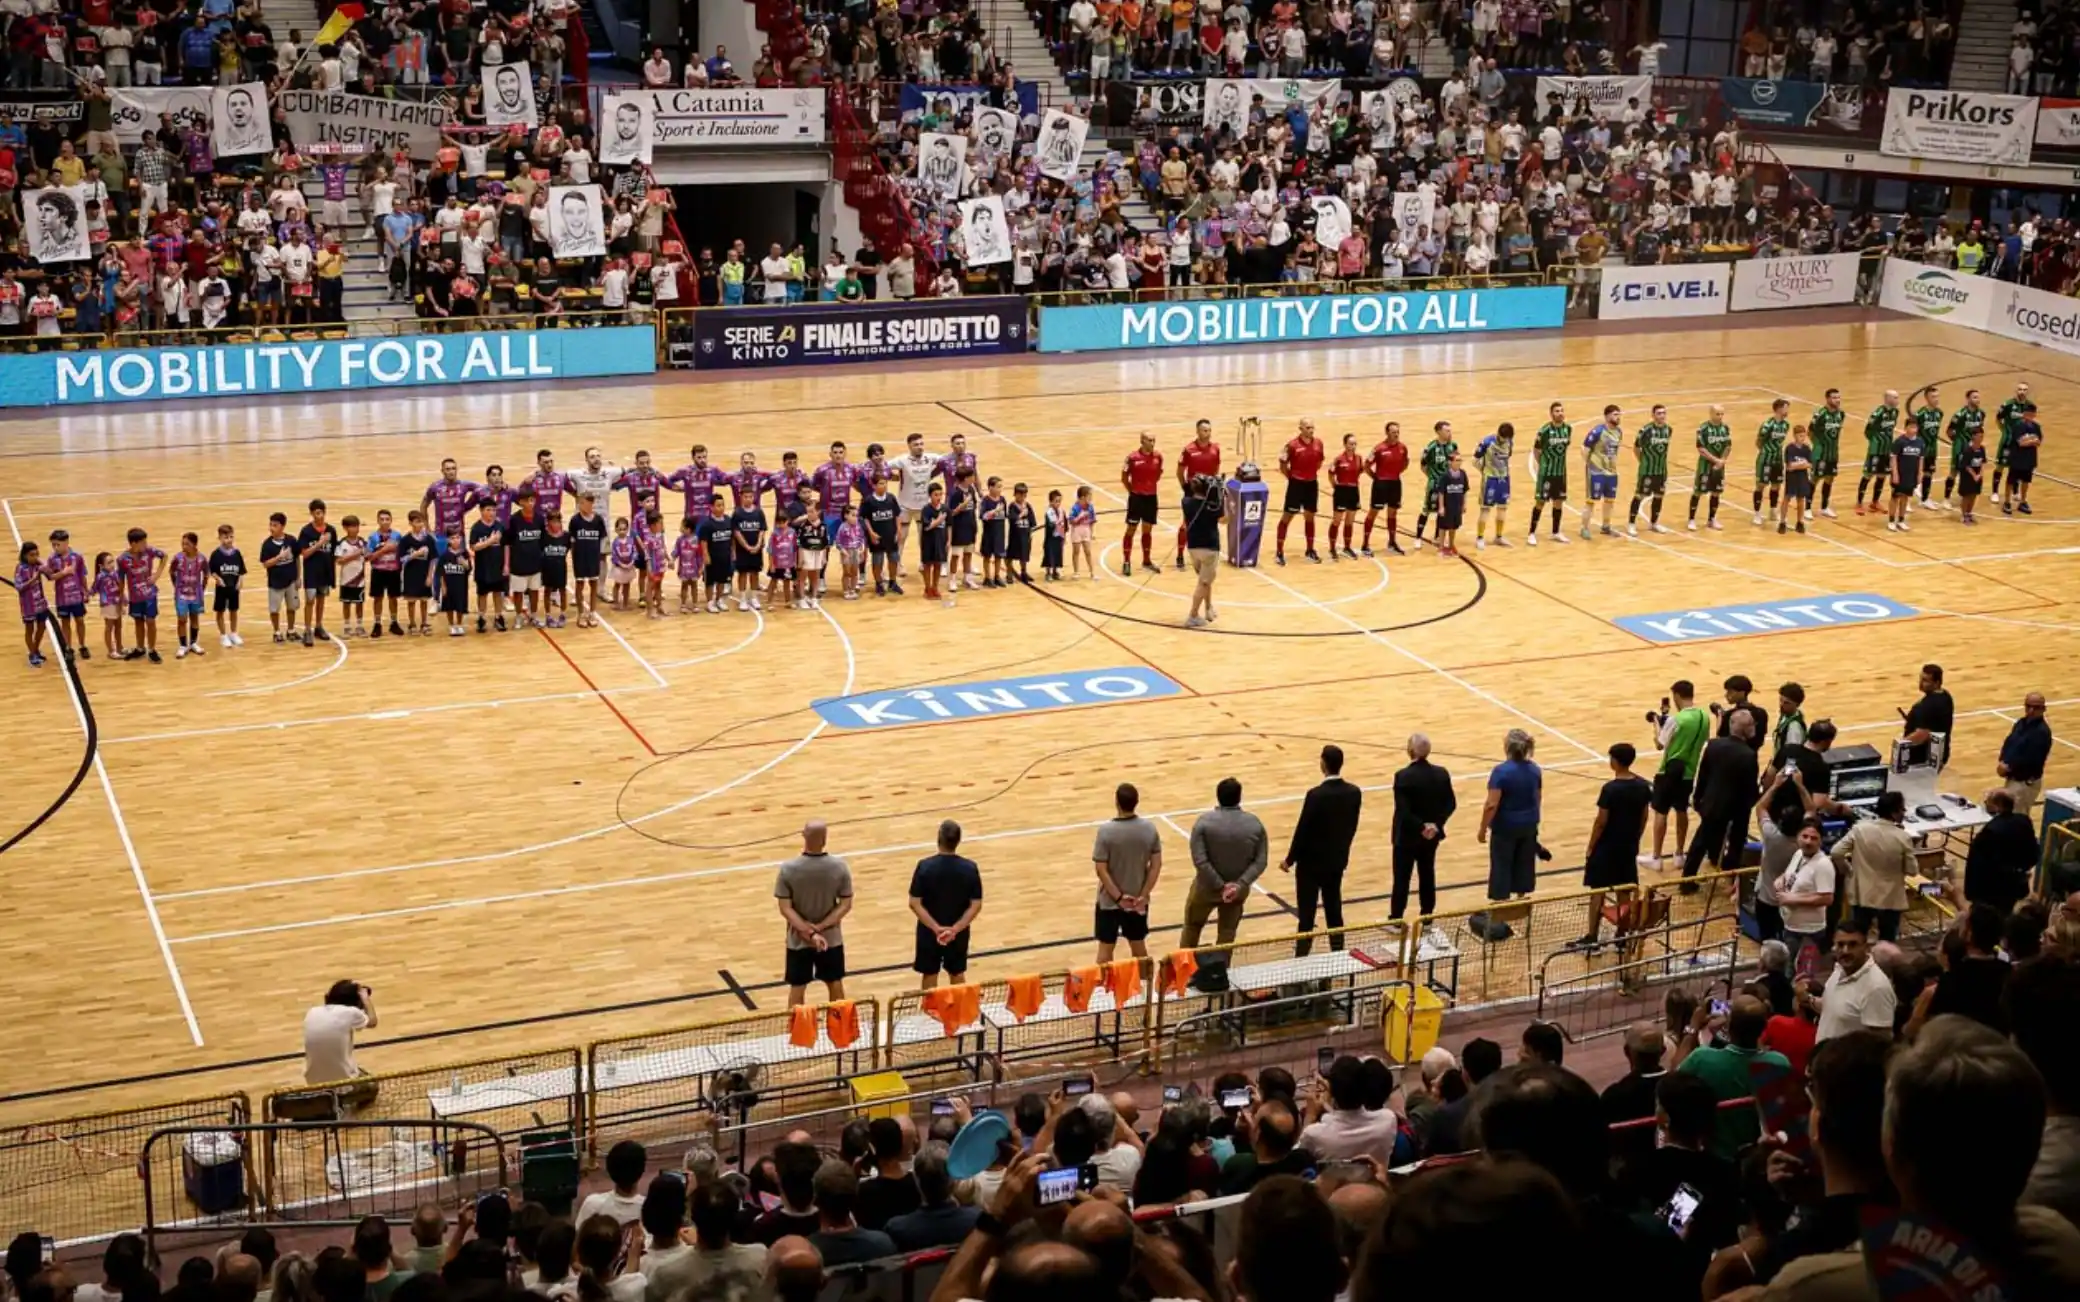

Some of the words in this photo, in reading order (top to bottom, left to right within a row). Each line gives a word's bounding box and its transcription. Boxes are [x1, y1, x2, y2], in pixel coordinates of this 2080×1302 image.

[284, 93, 444, 127] COMBATTIAMO
[672, 91, 765, 113] Catania
[1907, 93, 2015, 126] PriKors
[653, 121, 695, 139] Sport
[708, 119, 780, 137] Inclusione
[1765, 259, 1832, 279] LUXURY
[1904, 279, 1969, 304] ecocenter
[1121, 299, 1321, 345] MOBILITY
[1330, 296, 1408, 335] FOR
[1418, 292, 1488, 330] ALL
[724, 327, 774, 345] SERIE
[804, 319, 886, 349] FINALE
[887, 314, 1000, 346] SCUDETTO
[833, 345, 895, 357] STAGIONE
[56, 344, 325, 400] MOBILITY
[340, 339, 447, 385] FOR
[460, 335, 553, 378] ALL
